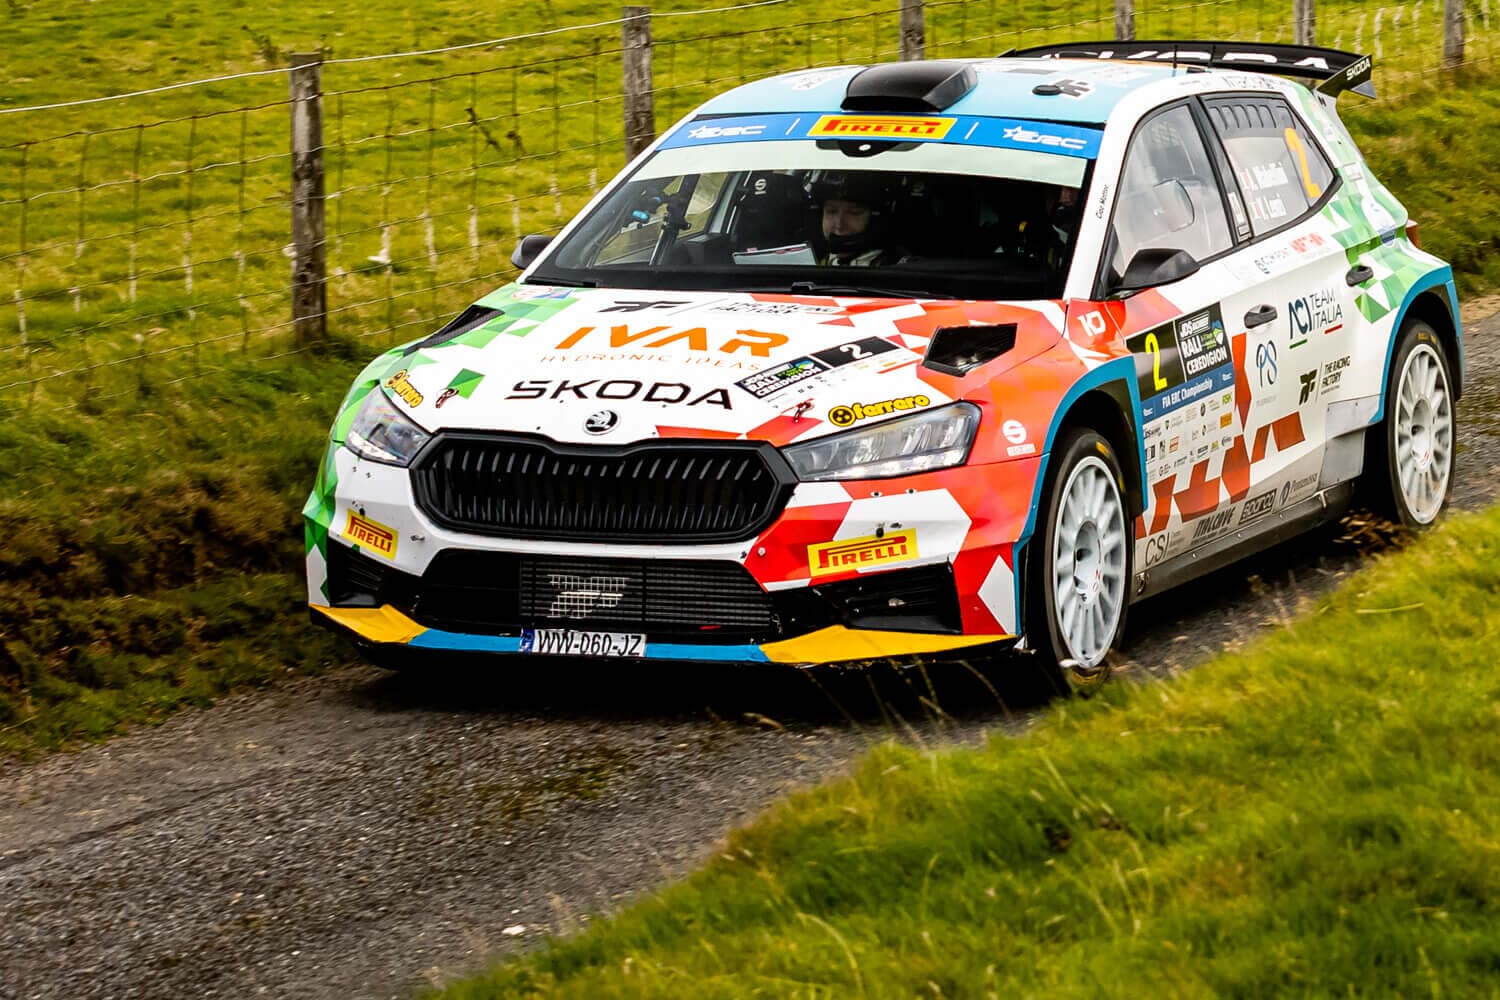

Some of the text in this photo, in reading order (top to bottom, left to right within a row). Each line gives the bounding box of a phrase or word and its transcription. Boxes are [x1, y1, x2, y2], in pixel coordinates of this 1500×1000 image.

[1346, 57, 1371, 81] SKODA
[822, 119, 942, 135] PIRELLI
[1284, 127, 1322, 199] 2
[1309, 287, 1336, 310] TEAM
[1312, 303, 1343, 331] ITALIA
[554, 324, 789, 358] IVAR
[839, 343, 873, 360] 2
[1180, 335, 1202, 359] RALI
[540, 352, 672, 363] HYDRONIC
[683, 356, 761, 371] IDEAS
[1144, 332, 1168, 392] 2
[1186, 345, 1228, 376] CEREDIGION
[505, 378, 733, 410] SKODA
[347, 515, 393, 553] PIRELLI
[1144, 532, 1170, 567] CSI
[818, 536, 907, 569] PIRELLI
